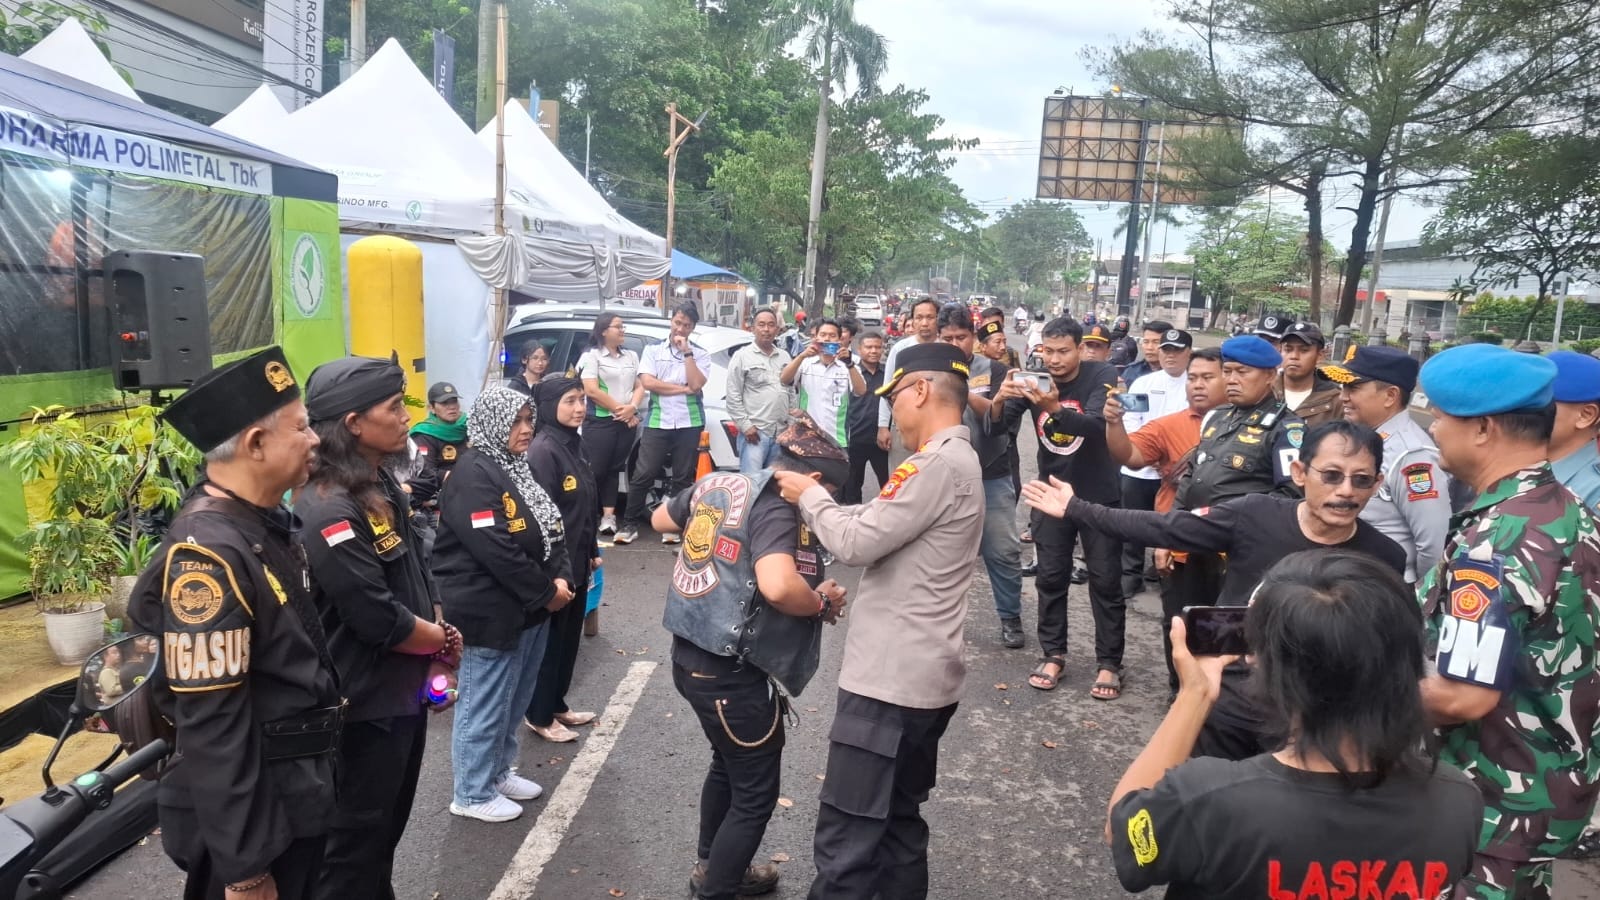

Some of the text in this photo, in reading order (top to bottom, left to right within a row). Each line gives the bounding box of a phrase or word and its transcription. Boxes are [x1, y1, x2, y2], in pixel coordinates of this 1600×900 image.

[114, 138, 226, 181] POLIMETAL
[229, 161, 258, 188] Tbk
[179, 561, 214, 571] TEAM
[1436, 614, 1506, 684] PM
[1268, 860, 1448, 900] LASKAR
